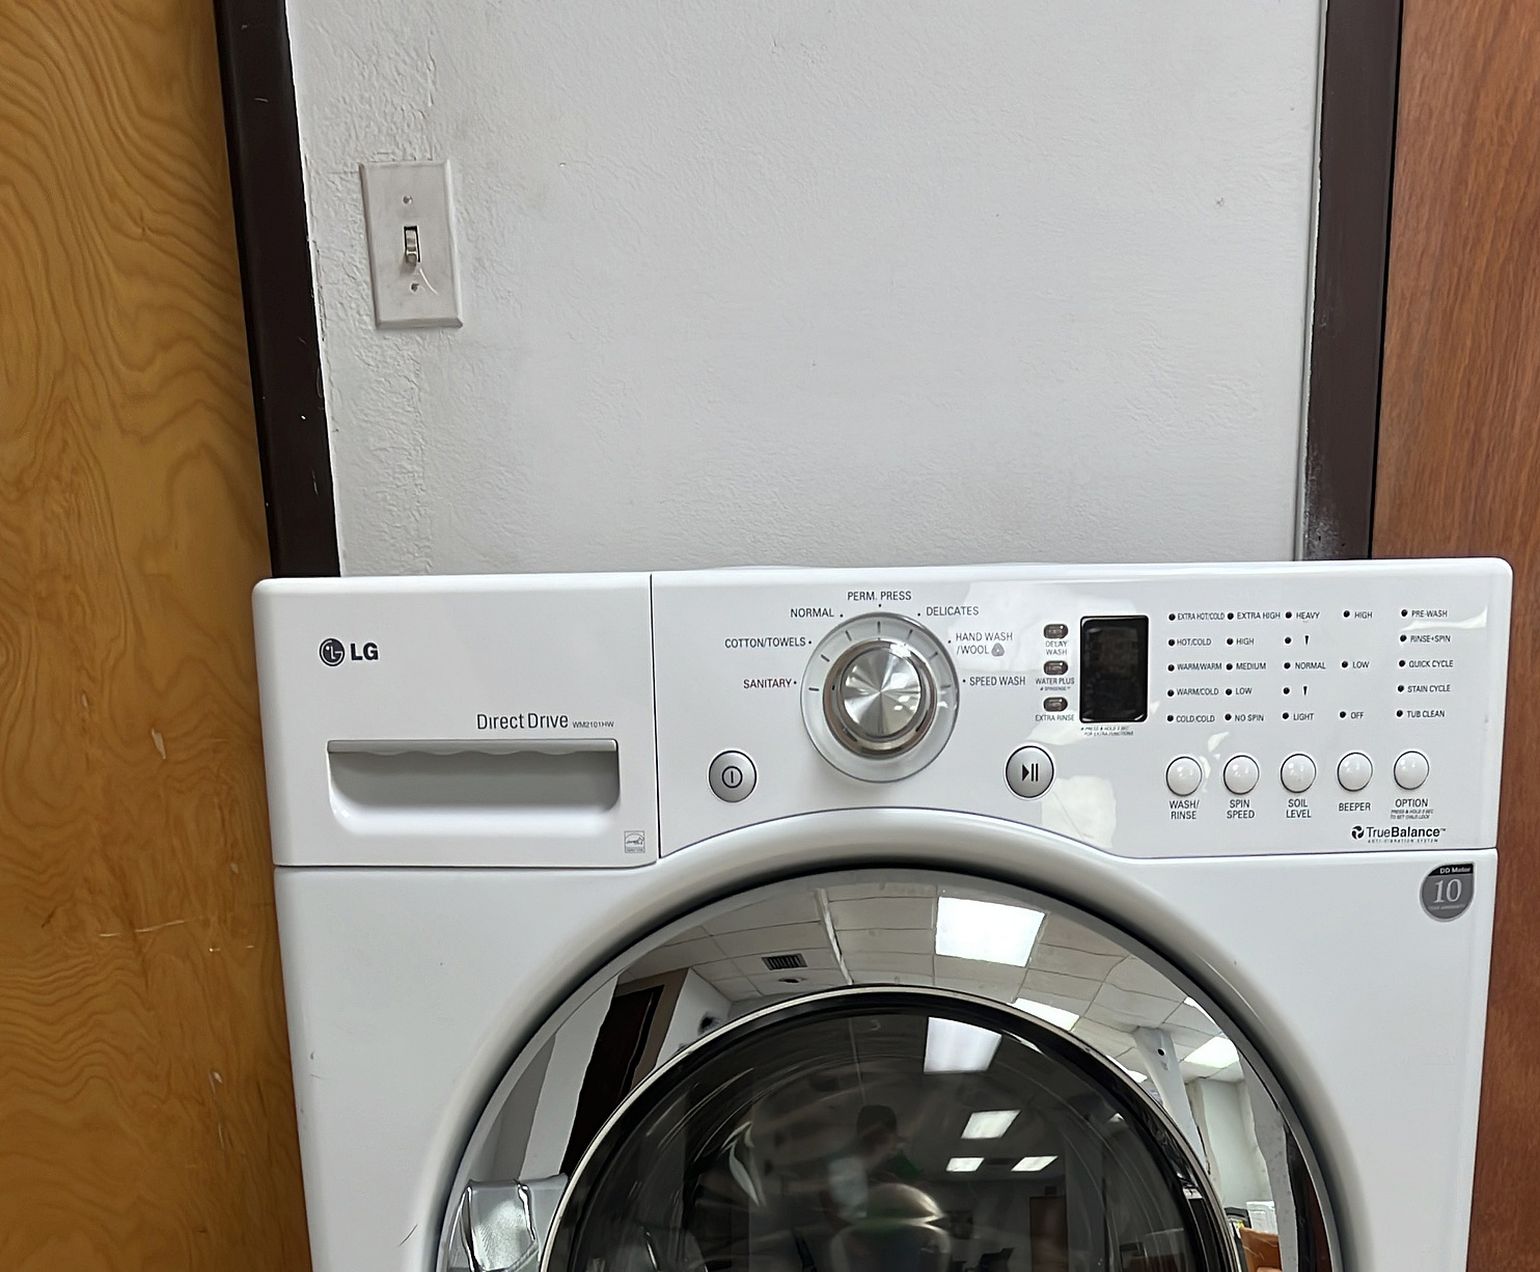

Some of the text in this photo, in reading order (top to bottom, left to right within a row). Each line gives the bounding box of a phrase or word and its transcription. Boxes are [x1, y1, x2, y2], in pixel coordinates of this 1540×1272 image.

[847, 591, 912, 601] PERM. PRESS
[790, 608, 834, 618] NORMAL
[926, 606, 979, 616] DELICATES
[956, 632, 1013, 641] HAND WASH
[725, 637, 806, 648] COTTON/TOWELS
[1177, 638, 1212, 646] HOT/COLD
[351, 642, 379, 661] LG
[956, 645, 989, 655] /WOOL
[1409, 660, 1430, 668] QUICK
[743, 679, 792, 689] SANITARY
[969, 676, 1026, 686] SPEED WASH
[1407, 710, 1445, 718] TUB CLEAN
[477, 713, 524, 730] Direct
[528, 713, 568, 729] Drive
[1170, 800, 1200, 809] WASH/
[1229, 800, 1250, 808] SPIN
[1288, 799, 1308, 807] SOIL
[1339, 802, 1371, 811] BEEPER
[1395, 799, 1428, 808] OPTION
[1171, 811, 1196, 820] RINSE
[1227, 810, 1255, 819] SPEED
[1286, 810, 1311, 818] LEVEL
[1434, 878, 1462, 903] 10
